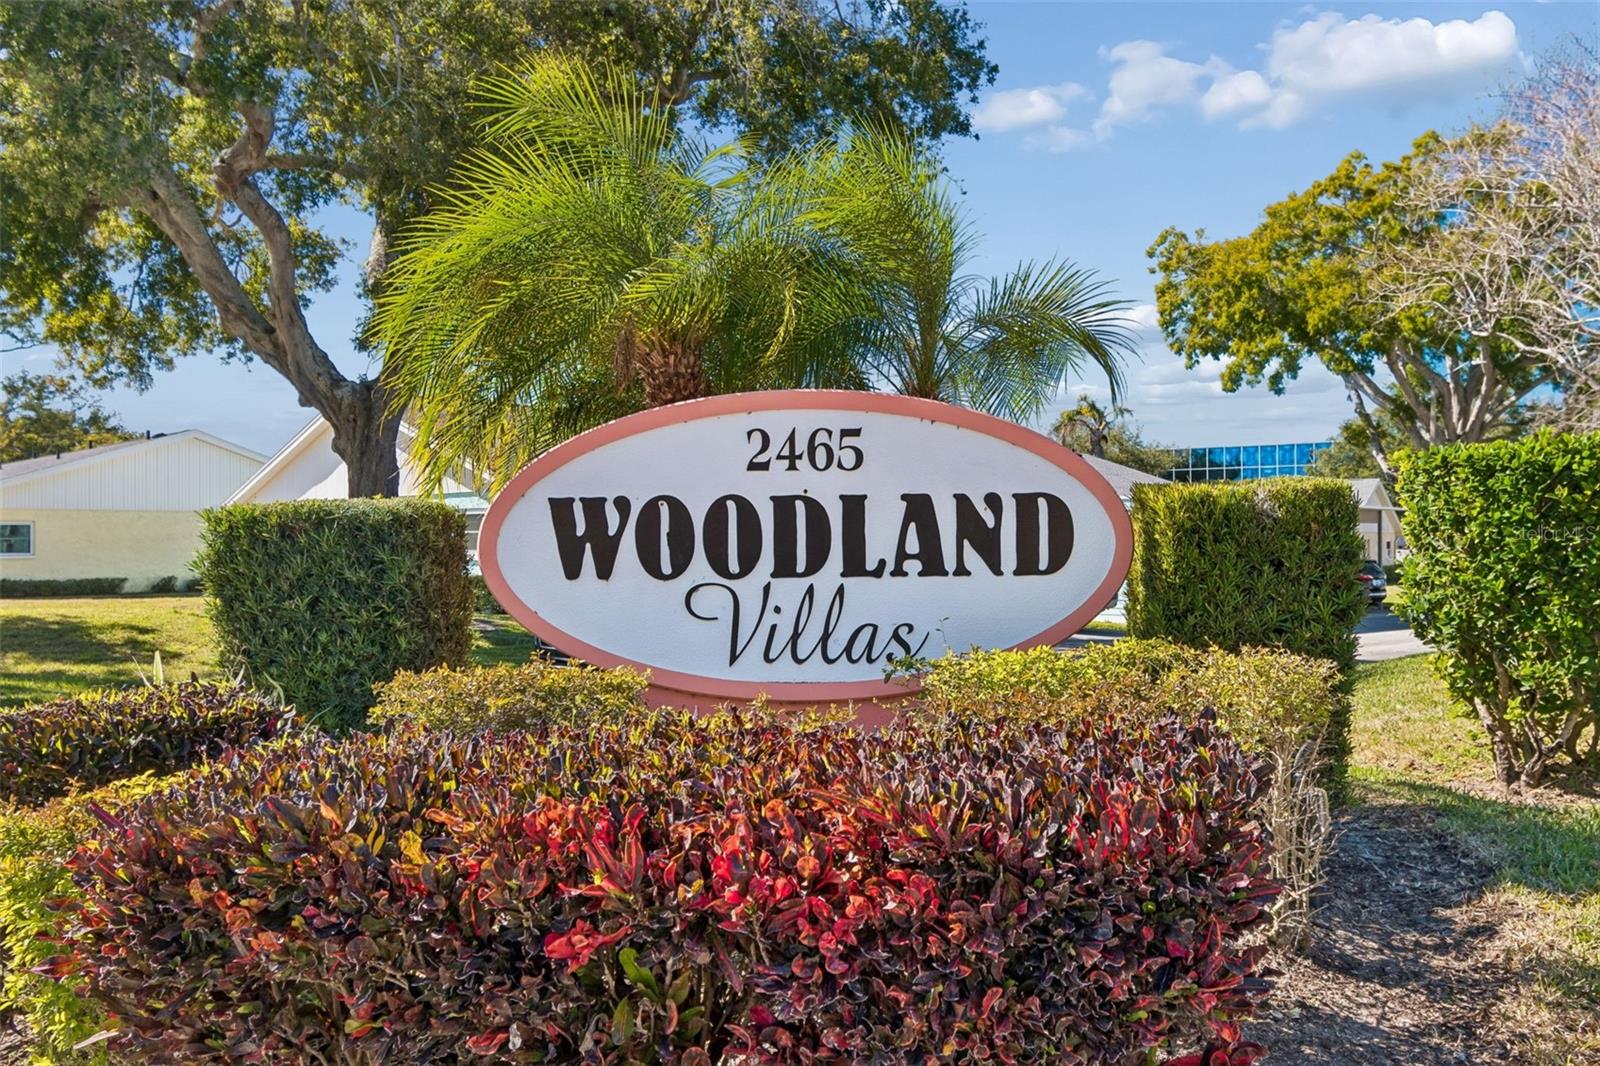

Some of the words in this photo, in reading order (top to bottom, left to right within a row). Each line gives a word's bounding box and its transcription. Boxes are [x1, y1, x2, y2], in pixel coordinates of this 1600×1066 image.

[747, 426, 864, 472] 2465
[547, 491, 1075, 582] WOODLAND
[684, 580, 930, 668] Villas
